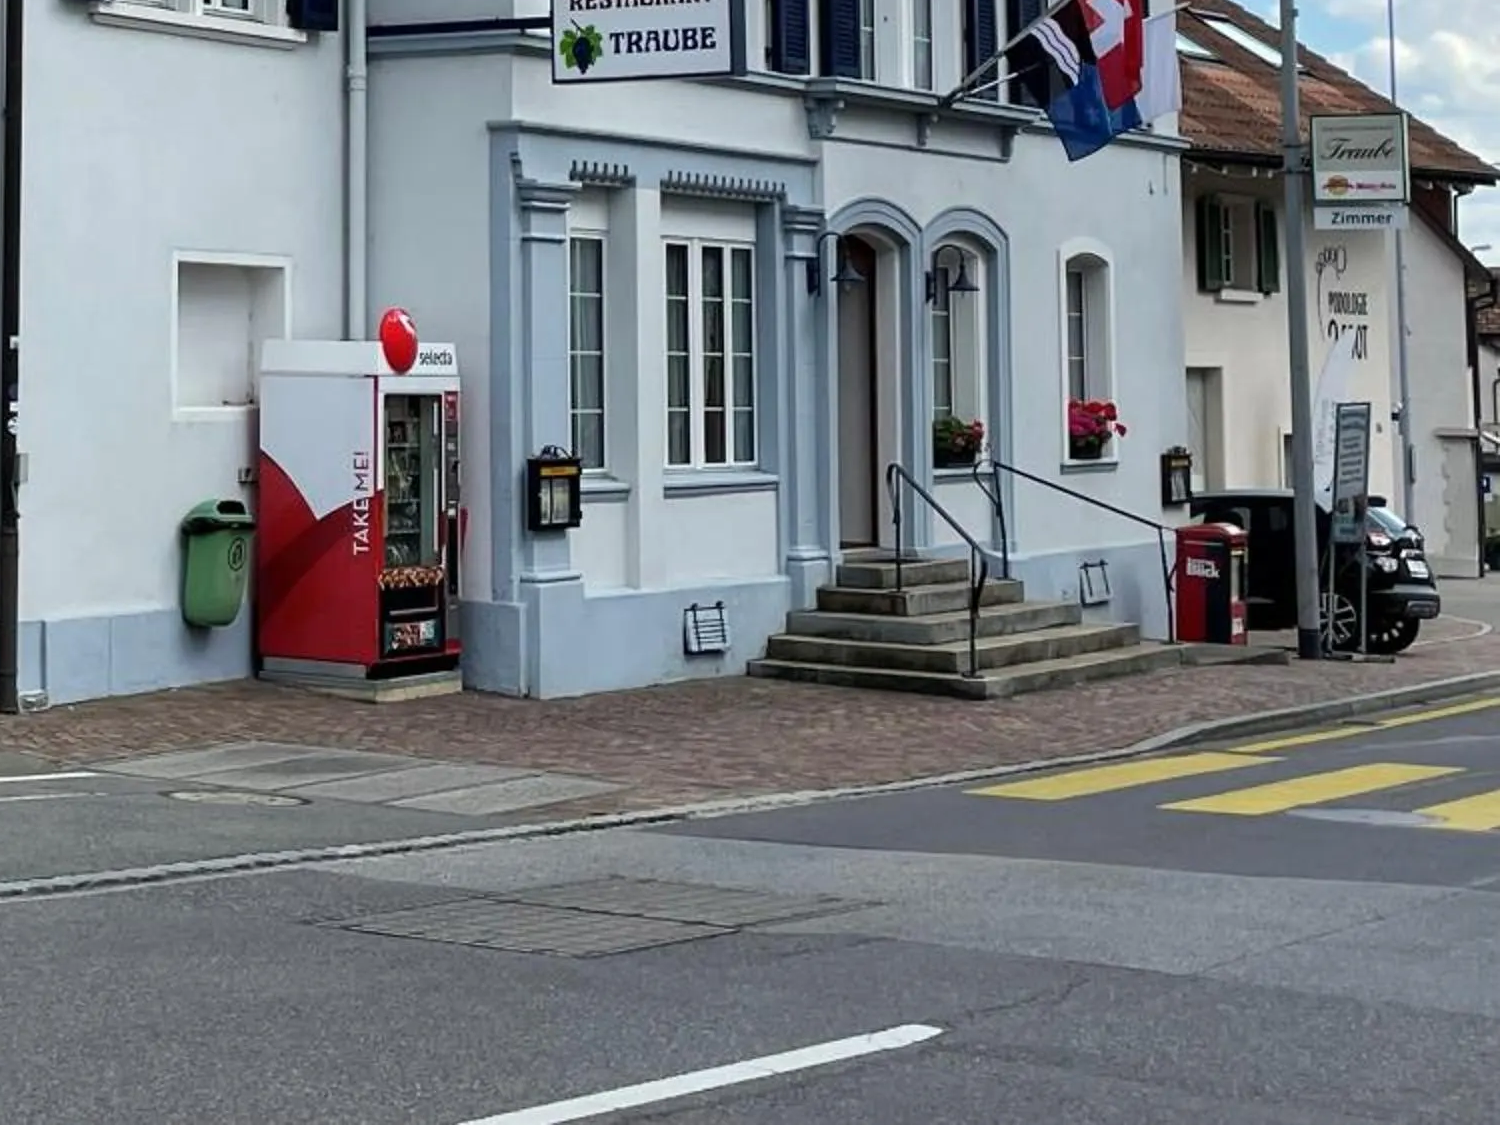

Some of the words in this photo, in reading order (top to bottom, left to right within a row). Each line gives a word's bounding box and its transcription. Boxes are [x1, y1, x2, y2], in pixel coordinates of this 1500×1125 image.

[609, 27, 717, 54] TRAUBE
[1321, 137, 1396, 161] Traube
[1331, 211, 1393, 225] Zimmer
[419, 349, 453, 366] selecta
[354, 450, 371, 492] ME!
[353, 496, 371, 556] TAKE
